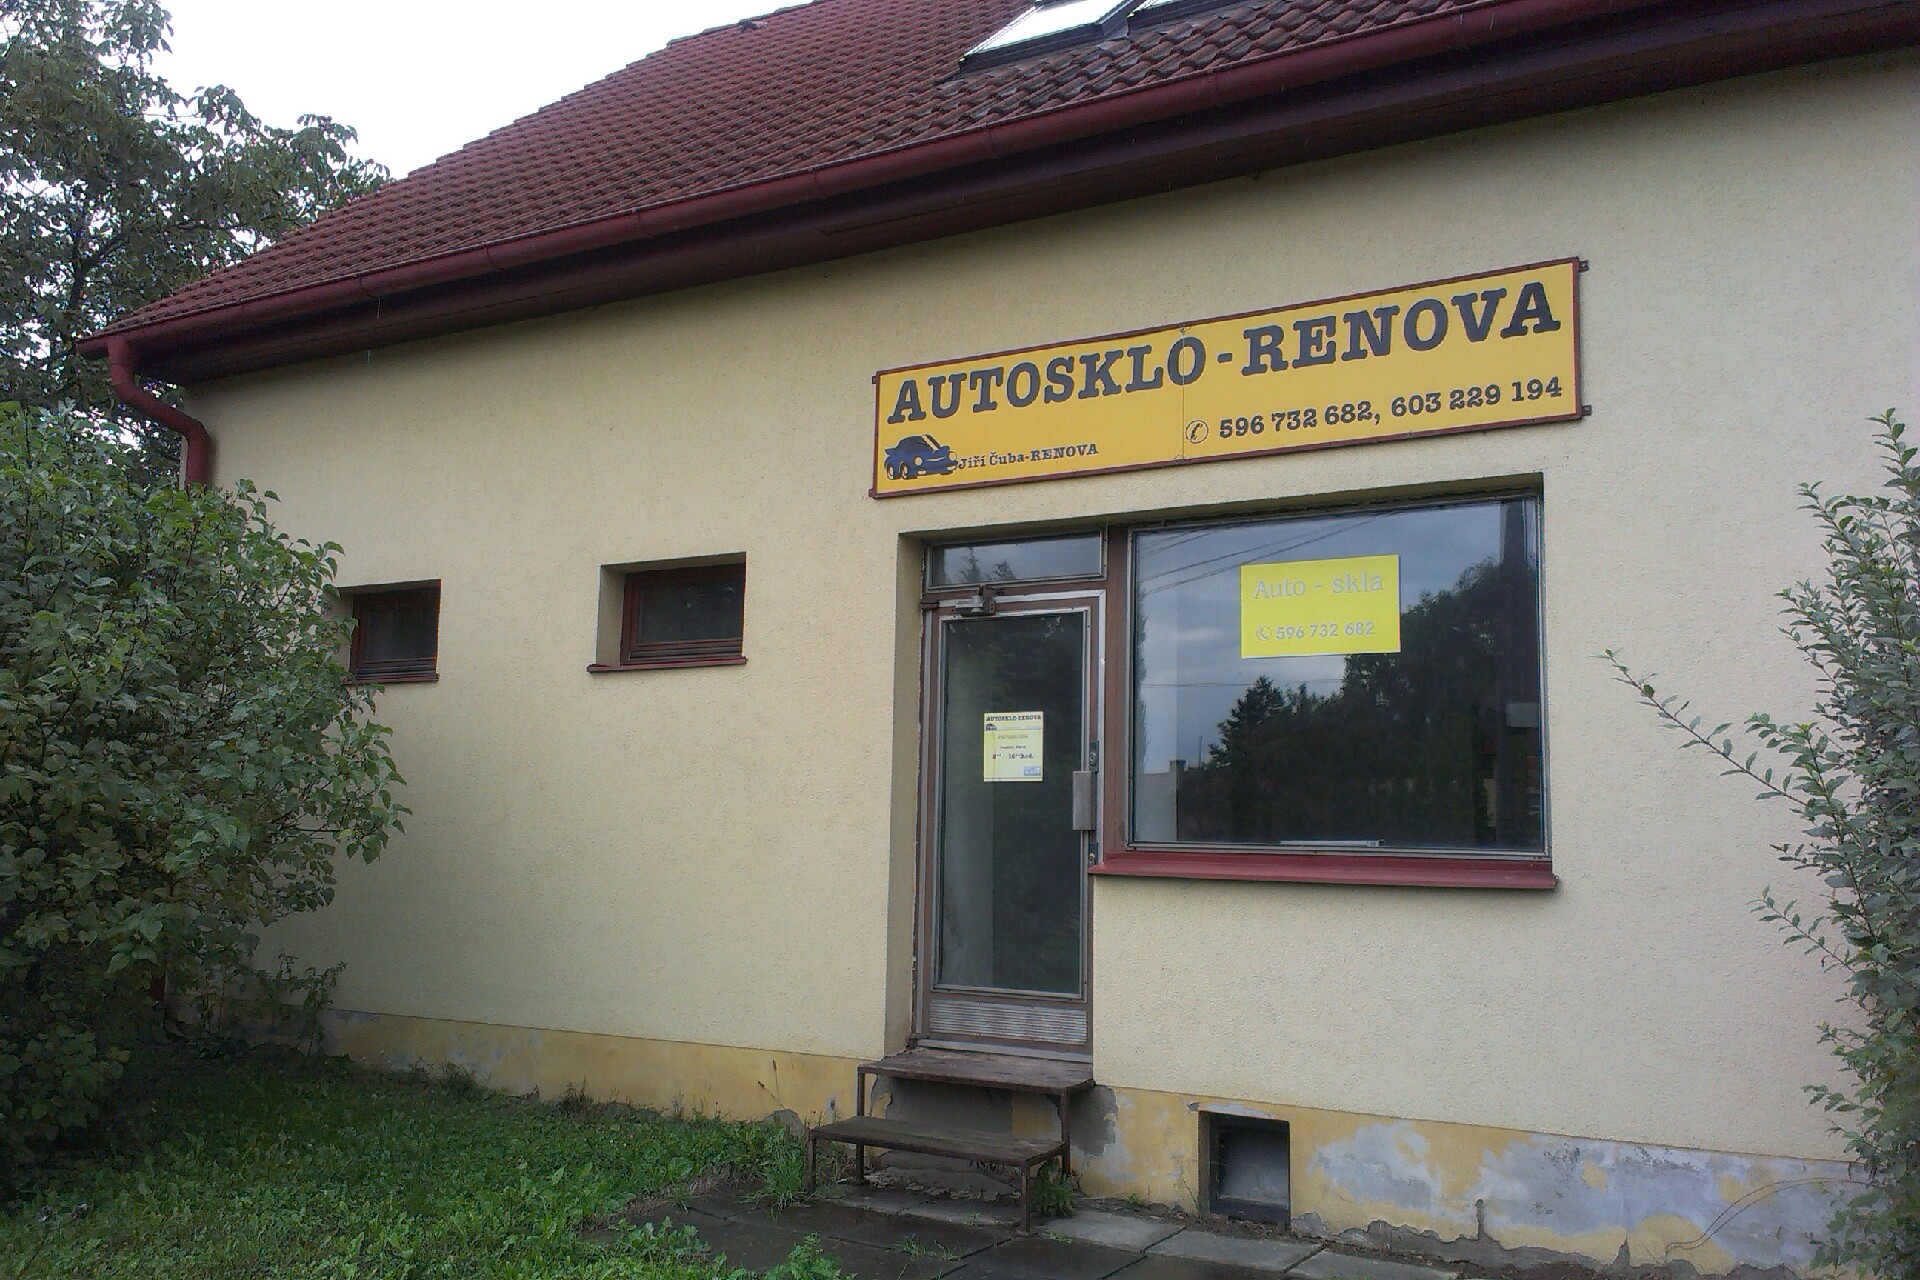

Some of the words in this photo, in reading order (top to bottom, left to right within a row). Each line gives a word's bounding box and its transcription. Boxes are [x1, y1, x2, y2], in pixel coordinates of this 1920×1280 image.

[886, 336, 1207, 425] AUTOSKLO
[1219, 415, 1265, 439] 596
[1270, 407, 1317, 432] 732
[1324, 400, 1381, 426] 682,
[1391, 391, 1442, 418] 603
[1449, 384, 1501, 410] 229
[1511, 376, 1562, 402] 194
[958, 455, 986, 470] Jiří
[1253, 579, 1306, 600] Auto
[1331, 571, 1384, 594] skla
[1275, 626, 1305, 640] 596
[1310, 623, 1338, 638] 732
[1344, 621, 1375, 636] 682
